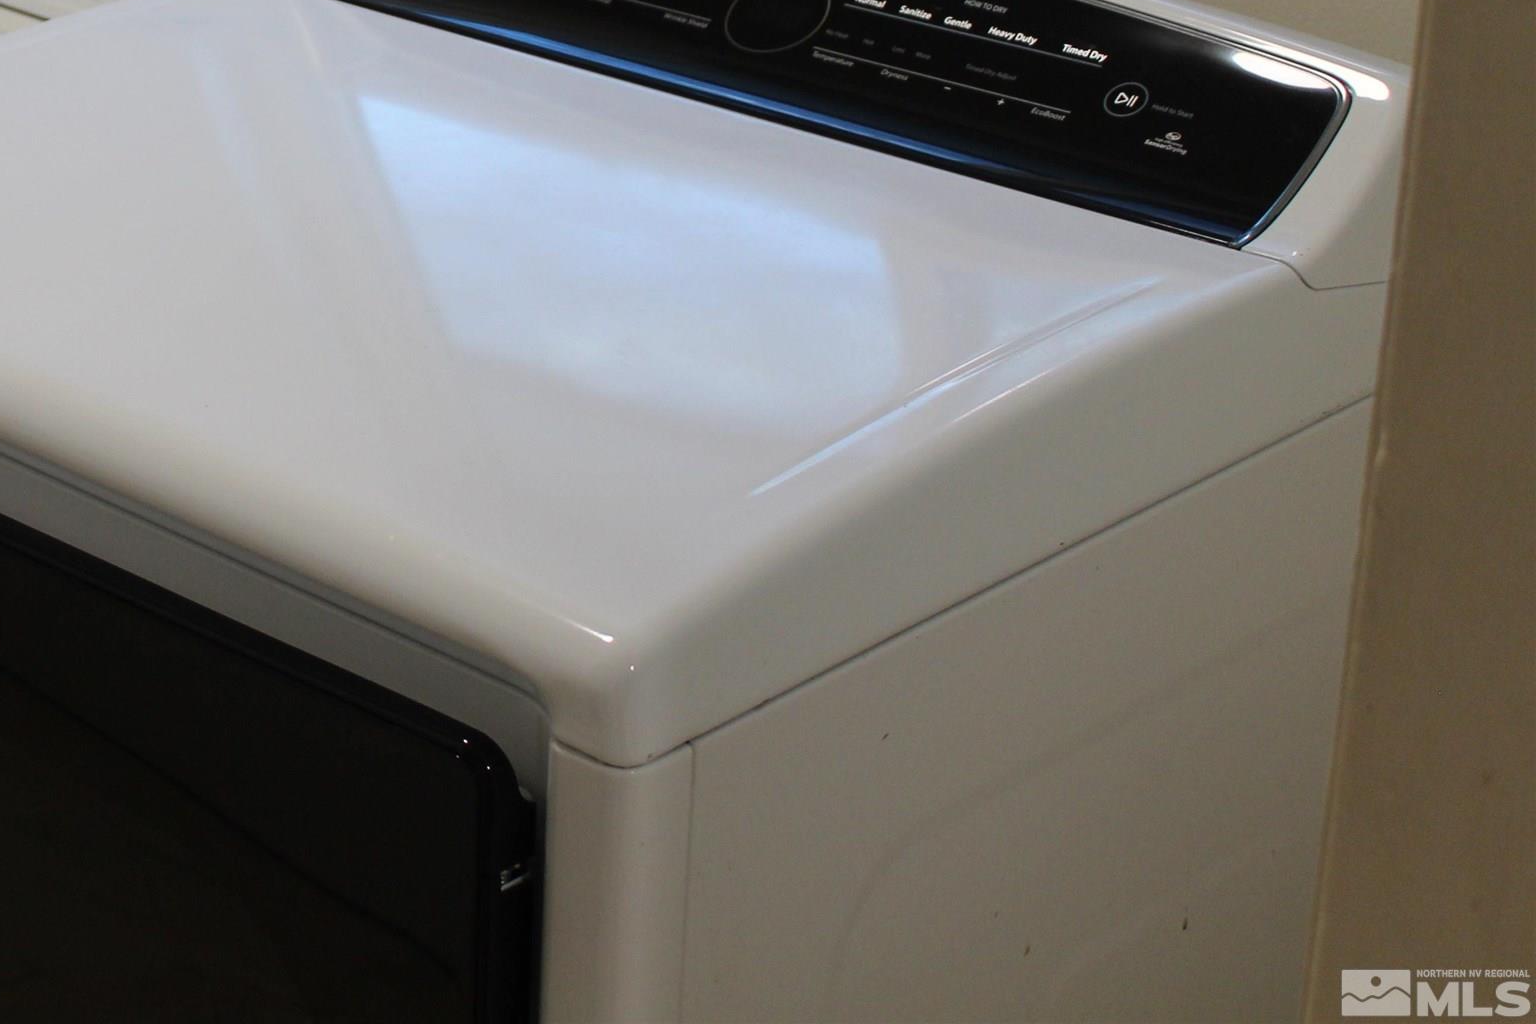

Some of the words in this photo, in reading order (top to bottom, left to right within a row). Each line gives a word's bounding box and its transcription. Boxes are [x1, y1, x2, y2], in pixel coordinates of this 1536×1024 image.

[983, 1, 992, 11] TO
[992, 3, 1008, 14] DRY
[898, 4, 933, 21] Sanitize
[943, 16, 973, 31] Gentle
[987, 25, 1014, 43] Heavy
[1014, 32, 1038, 46] Duty
[1062, 43, 1090, 58] Timed
[1089, 49, 1108, 63] Dry
[812, 50, 855, 68] Temperature
[880, 68, 909, 82] Dryness
[1030, 107, 1066, 121] EcoBoost
